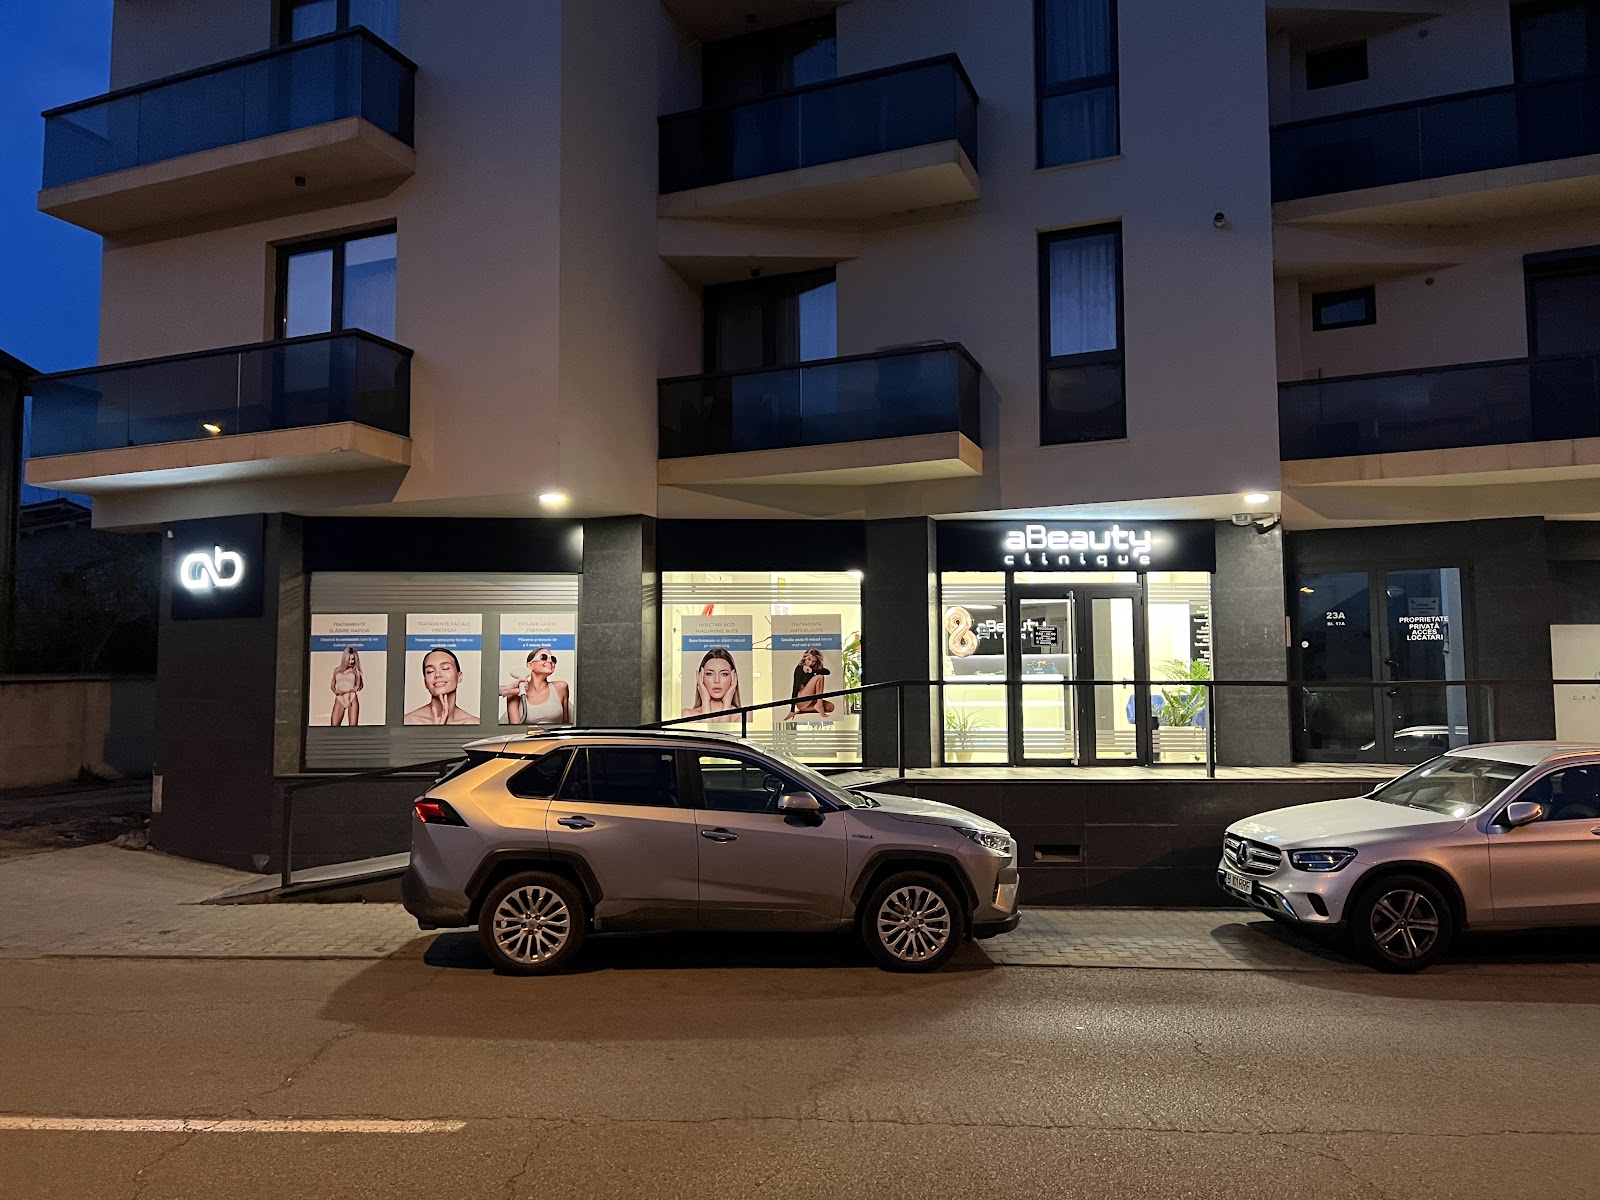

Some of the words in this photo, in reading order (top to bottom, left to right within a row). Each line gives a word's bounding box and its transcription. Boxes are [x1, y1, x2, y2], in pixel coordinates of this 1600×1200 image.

[1005, 524, 1151, 557] aBeauty
[1004, 552, 1151, 567] clinique
[1326, 612, 1345, 620] 23A
